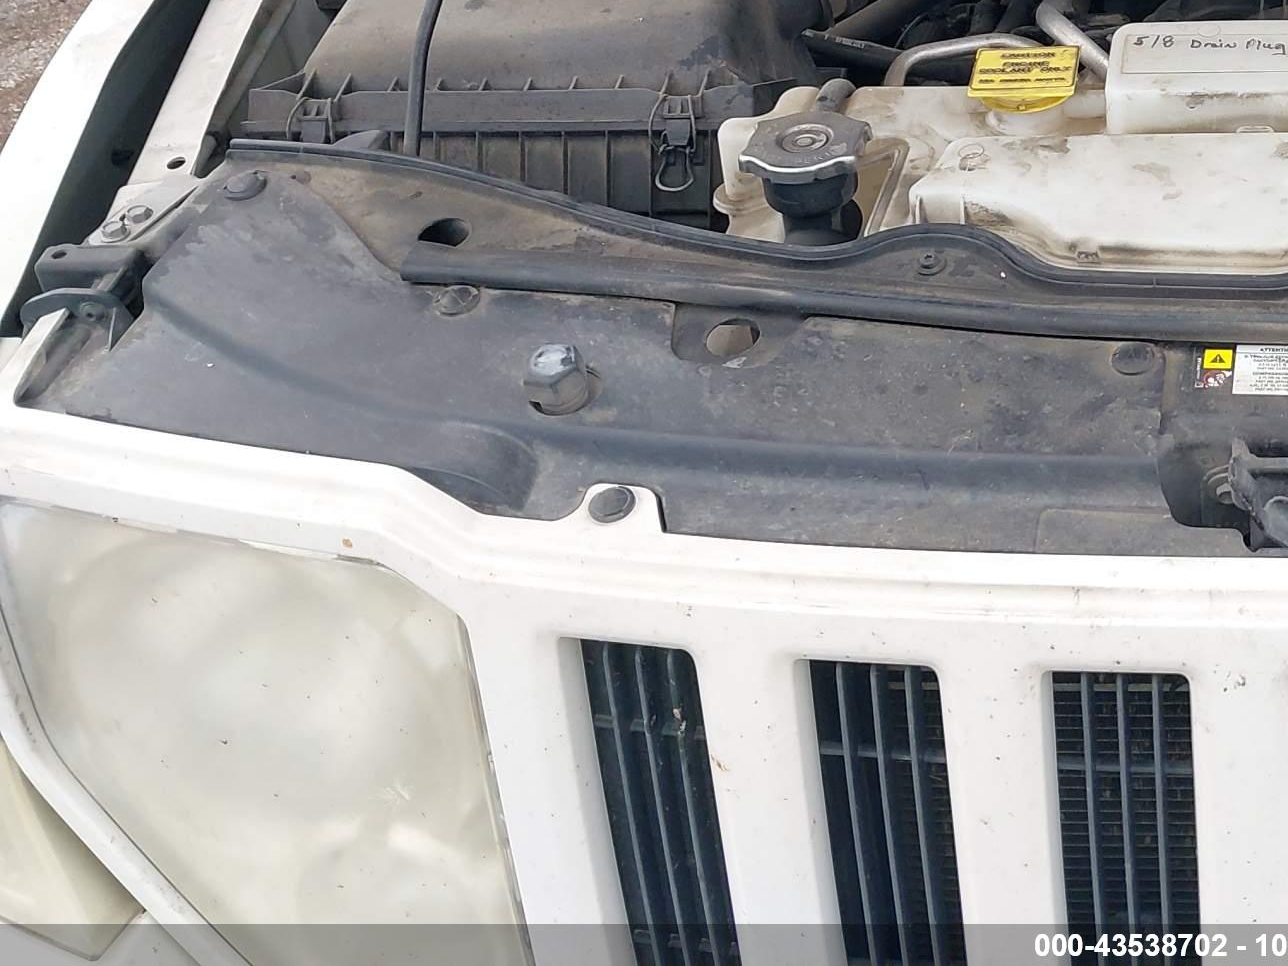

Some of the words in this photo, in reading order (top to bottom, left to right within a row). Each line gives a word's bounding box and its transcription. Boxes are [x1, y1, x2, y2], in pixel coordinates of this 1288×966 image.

[1132, 34, 1176, 49] 5/8
[1190, 38, 1238, 50] Drain
[1245, 38, 1288, 56] Plug
